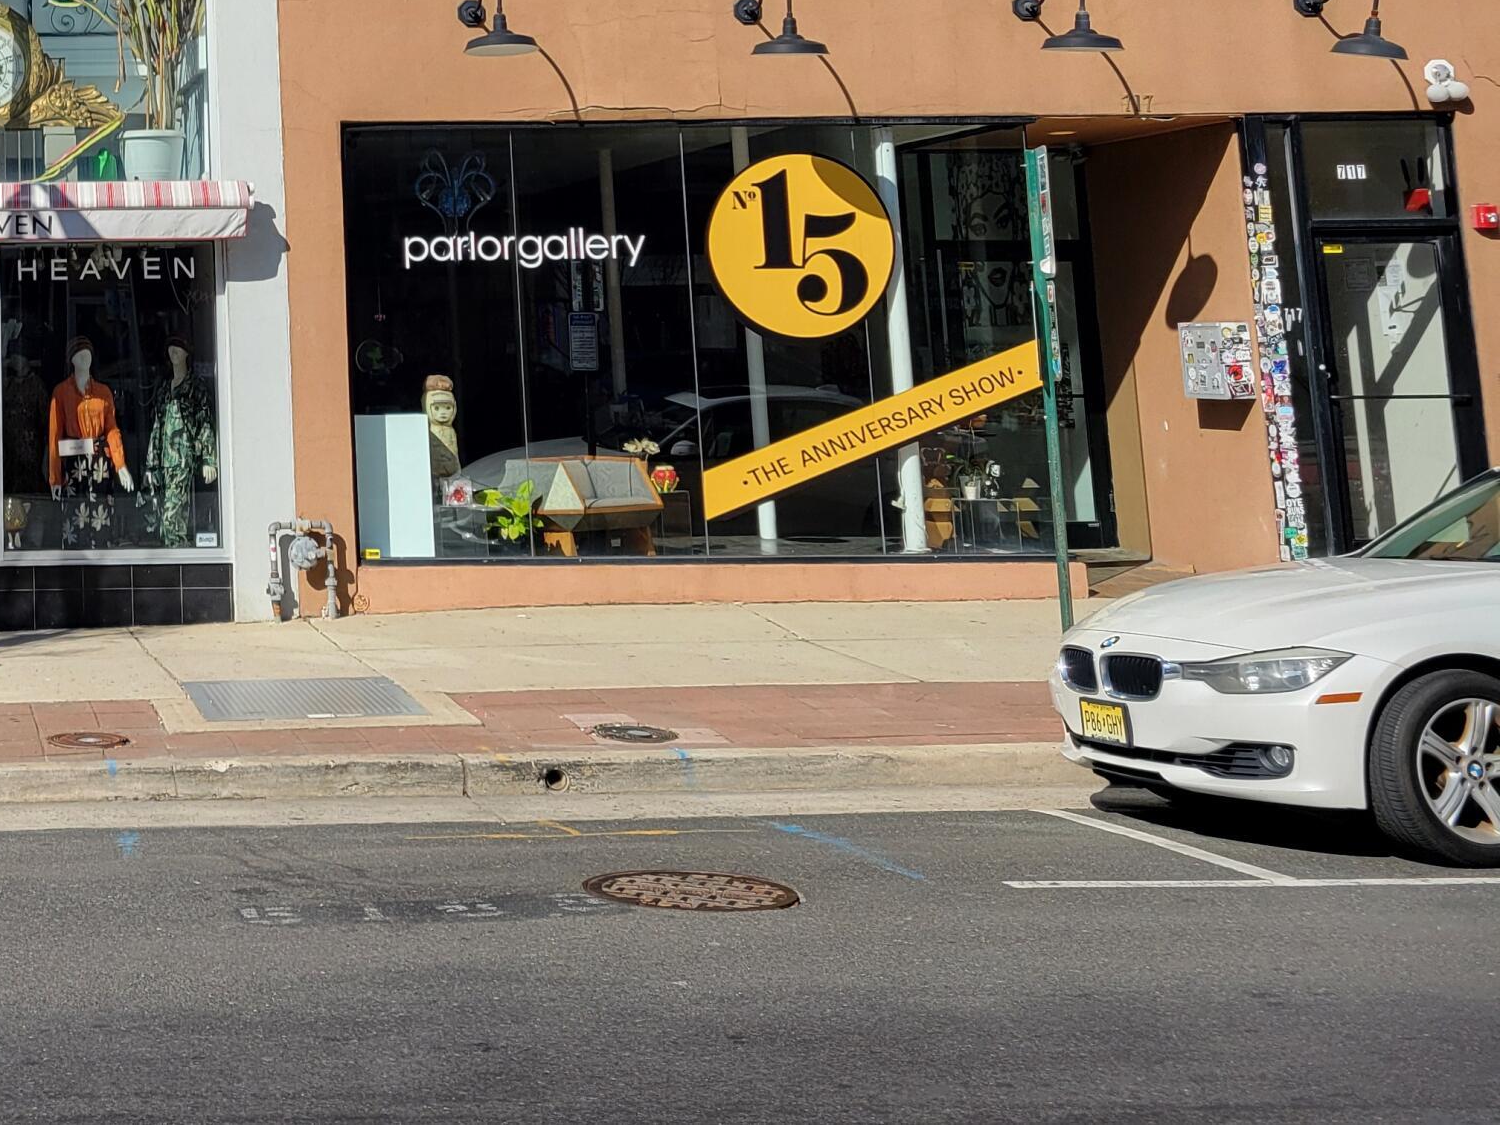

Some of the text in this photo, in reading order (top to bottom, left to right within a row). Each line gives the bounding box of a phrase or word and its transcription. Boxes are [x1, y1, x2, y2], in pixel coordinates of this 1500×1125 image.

[1337, 165, 1366, 179] 717
[404, 227, 646, 269] parlorgallery
[750, 168, 869, 316] 15
[16, 256, 196, 282] HEAVEN
[747, 457, 794, 487] THE
[800, 395, 946, 468] ANNIVERSARY
[949, 366, 1017, 406] SHOW
[1084, 710, 1123, 737] P86 GHY
